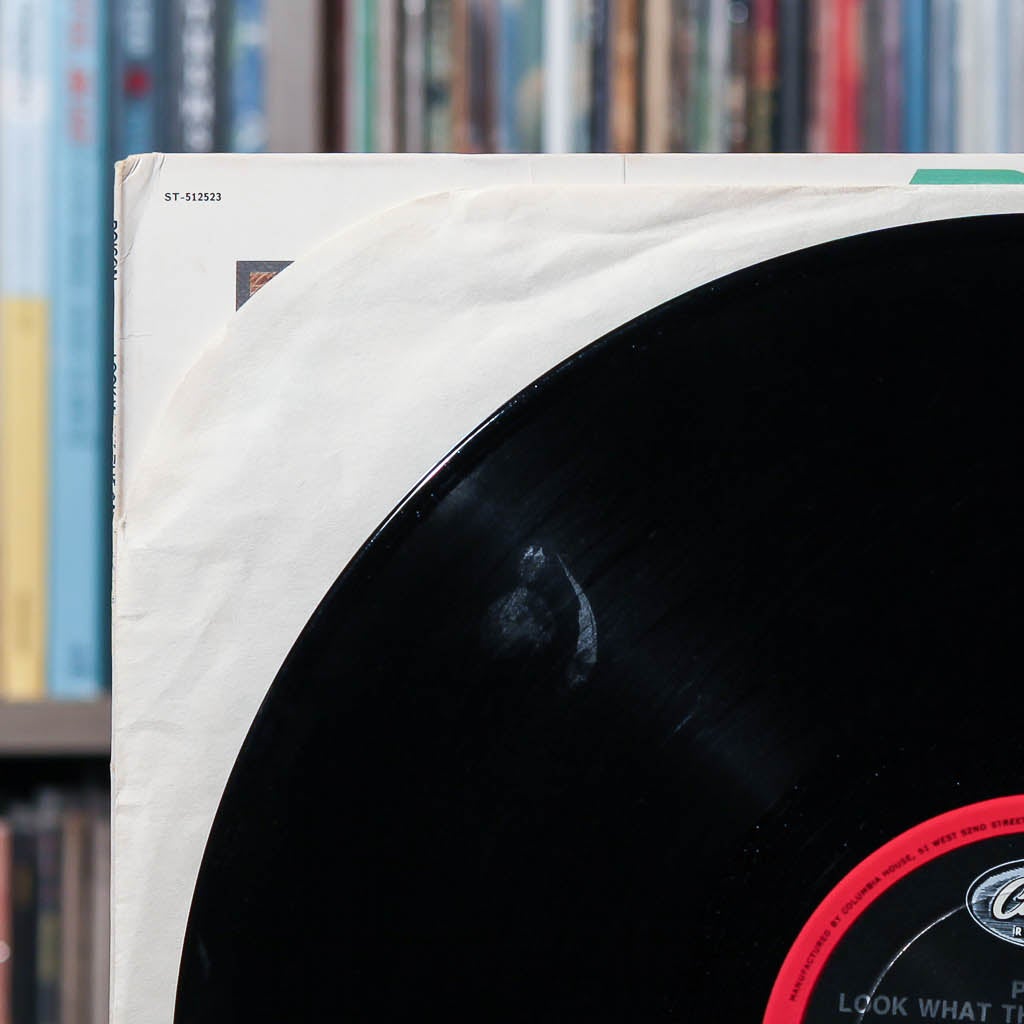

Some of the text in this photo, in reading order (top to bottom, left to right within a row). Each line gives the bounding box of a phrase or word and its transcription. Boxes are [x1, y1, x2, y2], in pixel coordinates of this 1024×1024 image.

[164, 192, 222, 202] ST-512523
[788, 927, 832, 1002] MANUFACTURED
[828, 914, 842, 929] BY
[839, 874, 882, 916] COLUMBIA
[880, 850, 916, 879] HOUSE,
[916, 843, 929, 855] 51
[931, 831, 957, 848] WEST
[959, 821, 986, 837] 52ND
[839, 992, 909, 1017] LOOK
[918, 997, 992, 1022] WHAT
